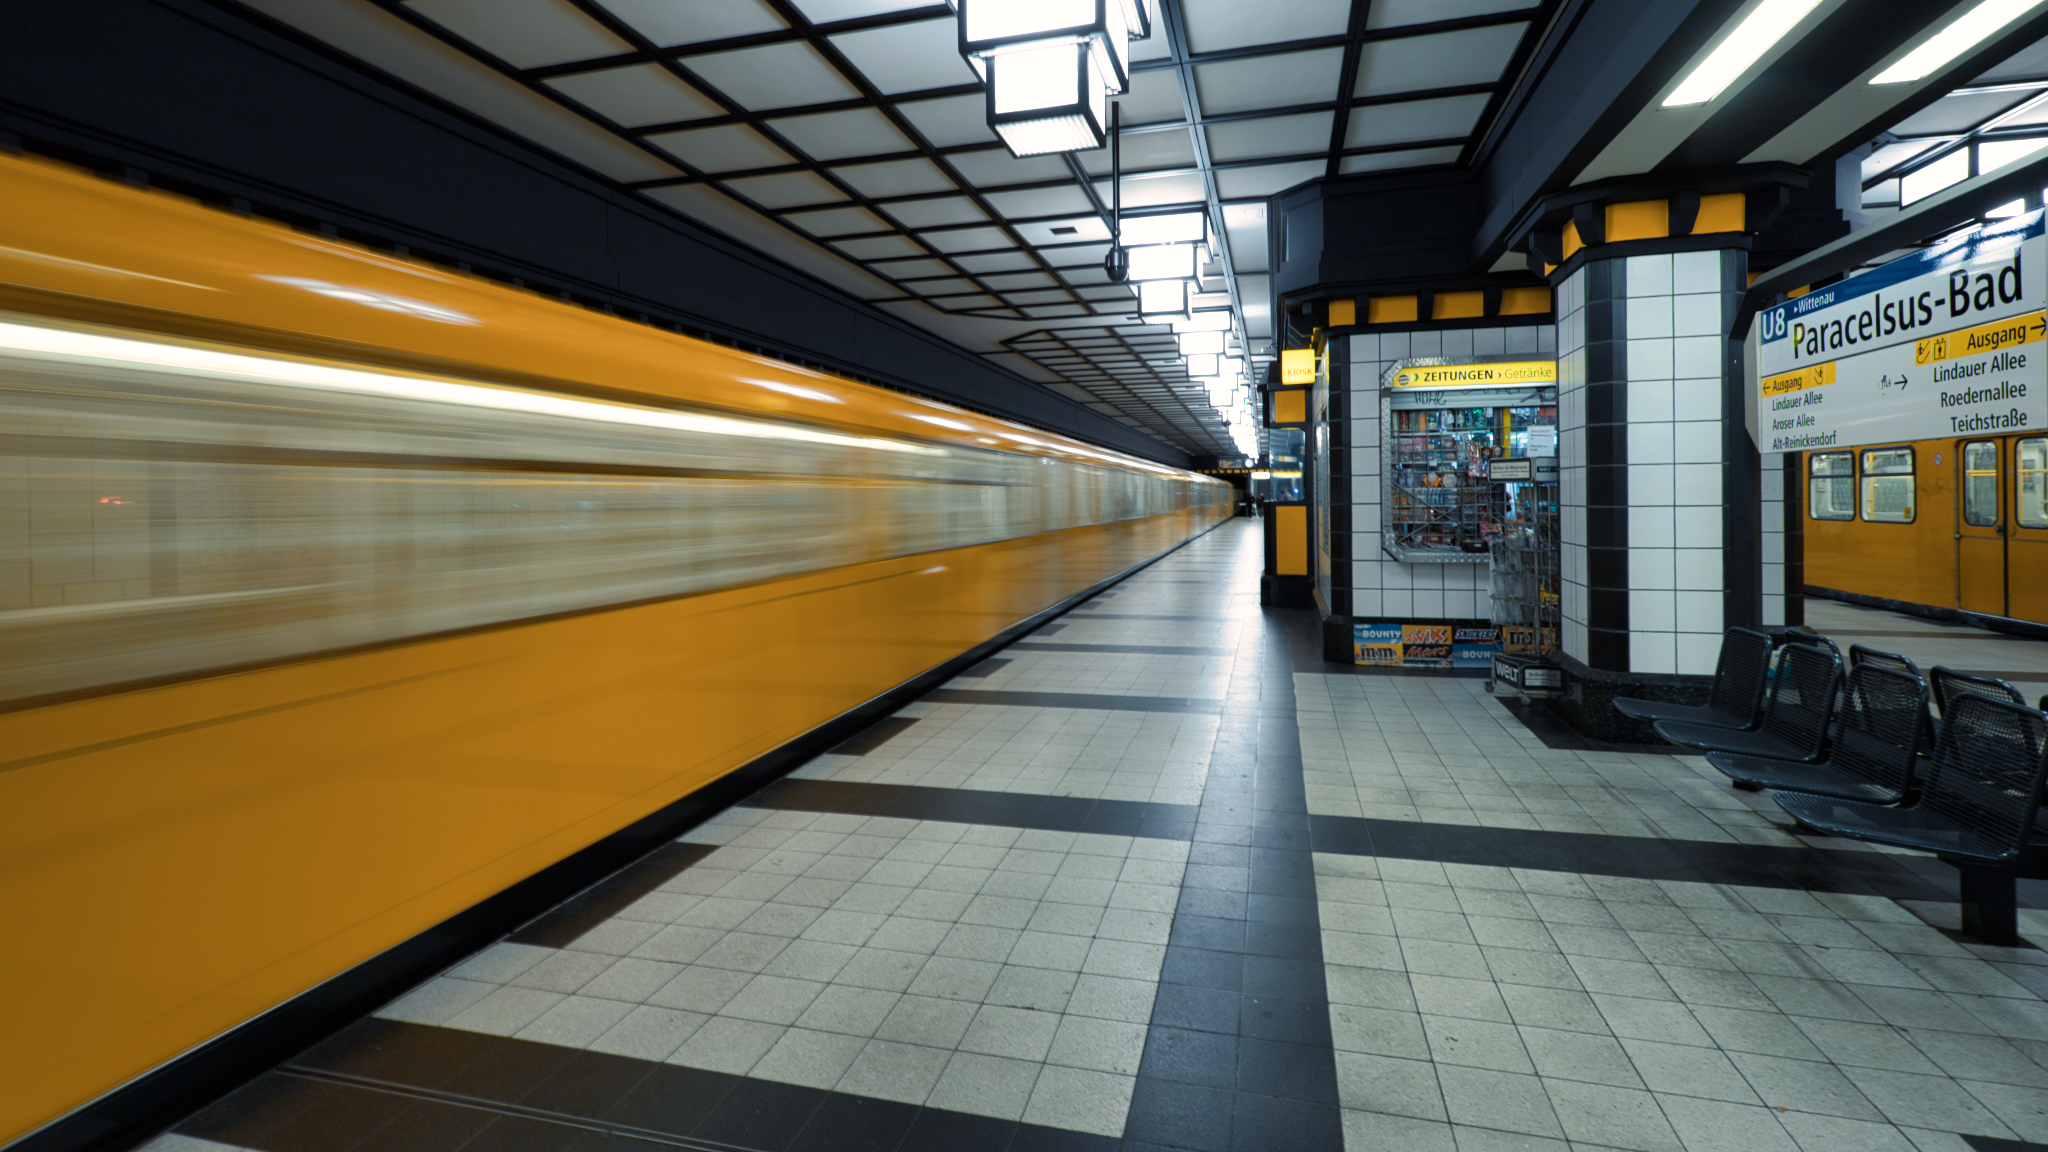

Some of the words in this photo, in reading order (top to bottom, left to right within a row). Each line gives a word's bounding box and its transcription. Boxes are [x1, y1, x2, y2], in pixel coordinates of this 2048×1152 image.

[1793, 247, 2023, 360] Paracelsus-Bad
[1798, 291, 1835, 313] Wittenau
[1762, 307, 1785, 340] U8
[1966, 324, 2027, 350] Ausgang
[1287, 368, 1313, 376] KIOSK
[1423, 369, 1494, 382] ZEITUNGEN
[1504, 367, 1552, 380] Getränke
[1933, 361, 1987, 383] Lindauer
[1990, 351, 2027, 374] Allee
[1772, 376, 1803, 393] Ausgang
[1940, 380, 2027, 408] Roedernallee
[1772, 396, 1802, 412] Lindauer
[1803, 391, 1823, 407] Allee
[1772, 418, 1795, 431] Aroser
[1796, 413, 1815, 427] Allee
[1950, 408, 2028, 433] Teichstraße
[1772, 430, 1837, 450] Alt-Reinickendorf
[1362, 629, 1402, 639] BOUNTY
[1456, 628, 1497, 640] SNICKERS
[1462, 650, 1491, 659] BOUN
